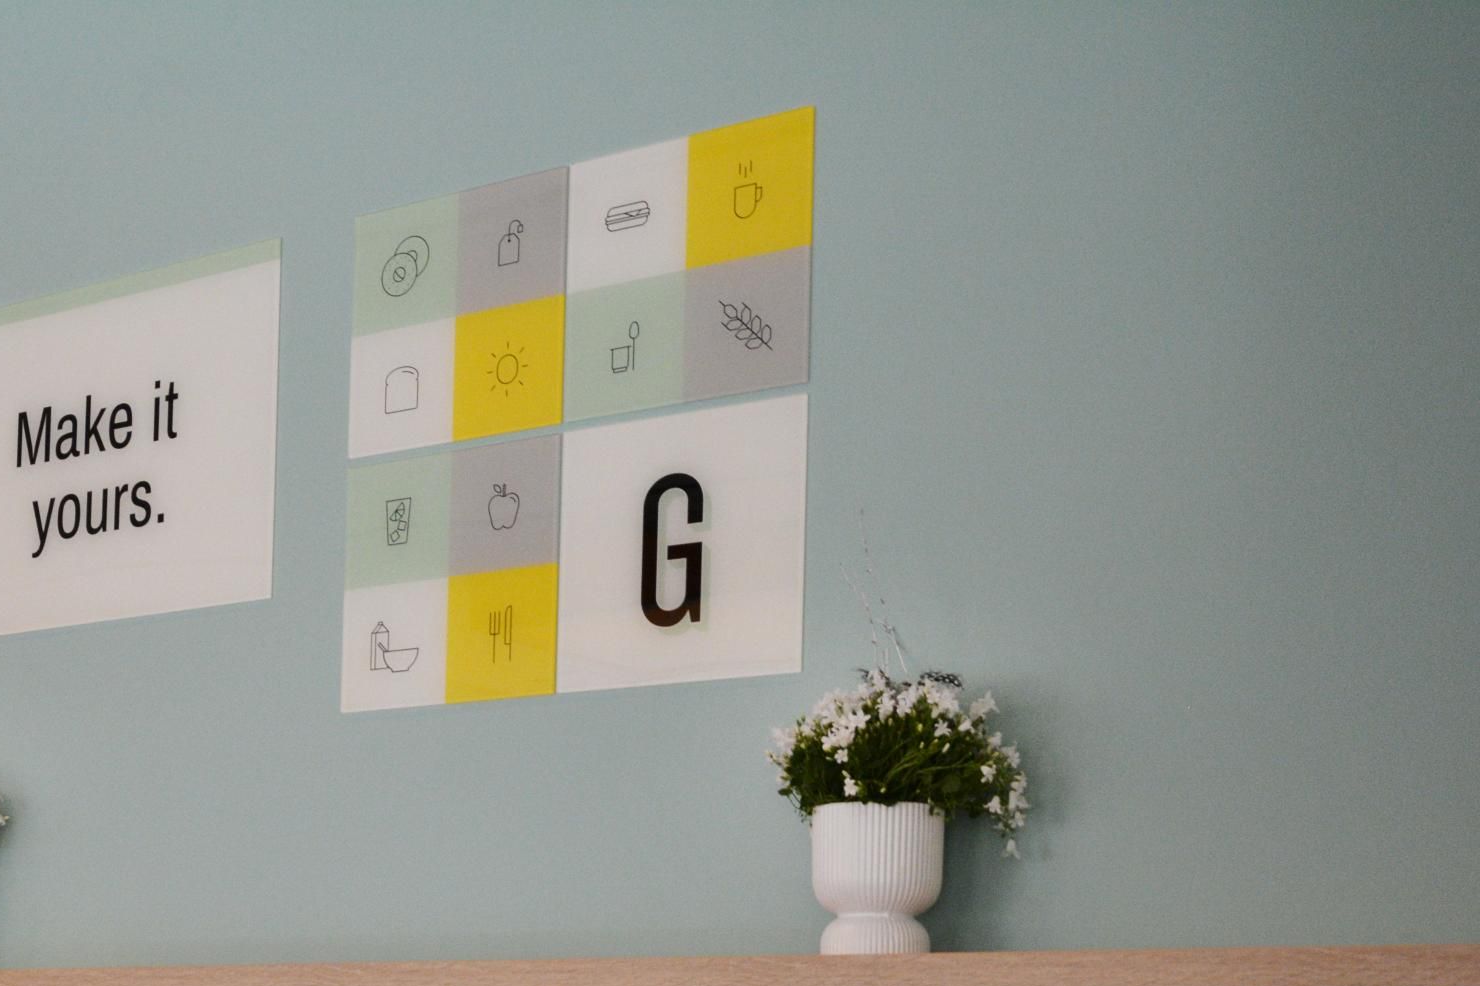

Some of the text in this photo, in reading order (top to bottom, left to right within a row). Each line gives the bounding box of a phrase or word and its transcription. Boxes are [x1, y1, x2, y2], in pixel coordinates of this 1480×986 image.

[16, 380, 180, 468] Make it
[31, 480, 165, 559] yours.
[641, 472, 704, 628] G
